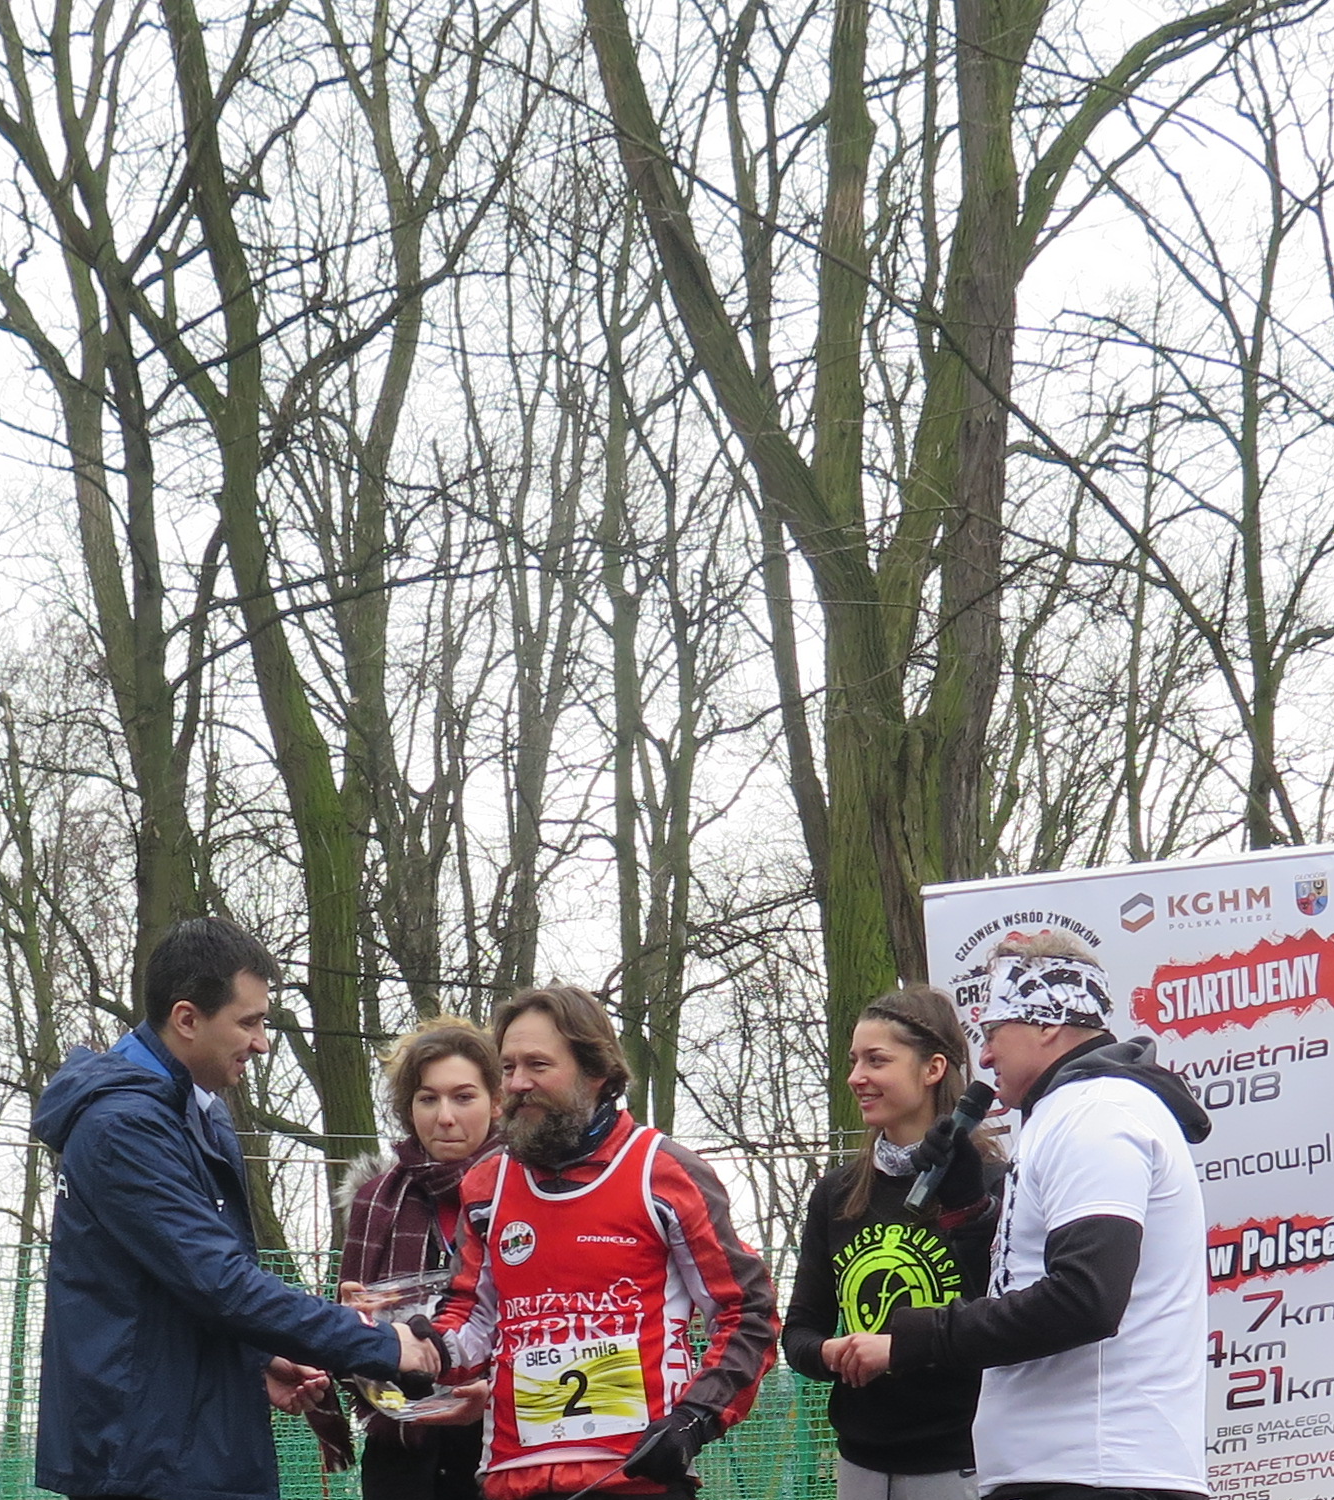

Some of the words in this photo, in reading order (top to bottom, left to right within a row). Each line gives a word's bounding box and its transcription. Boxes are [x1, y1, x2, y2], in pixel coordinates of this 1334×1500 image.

[1168, 886, 1272, 918] KGHM
[954, 919, 1001, 962] CZŁOWIEK
[1002, 909, 1044, 927] WŚRÓD
[1046, 910, 1102, 949] ŻYWIOŁÓW
[1169, 919, 1221, 931] POLSKA
[1230, 912, 1273, 926] MIEDŹ
[1156, 953, 1320, 1024] STARTUJEMY
[1169, 1037, 1329, 1081] kwietnia
[1209, 1243, 1235, 1278] w
[505, 1287, 618, 1320] DRUŻYNA
[525, 1348, 562, 1367] BIEG
[582, 1340, 619, 1360] mila
[559, 1369, 592, 1418] 2
[1216, 1423, 1254, 1438] BIEG
[1257, 1413, 1331, 1433] MAŁEGO
